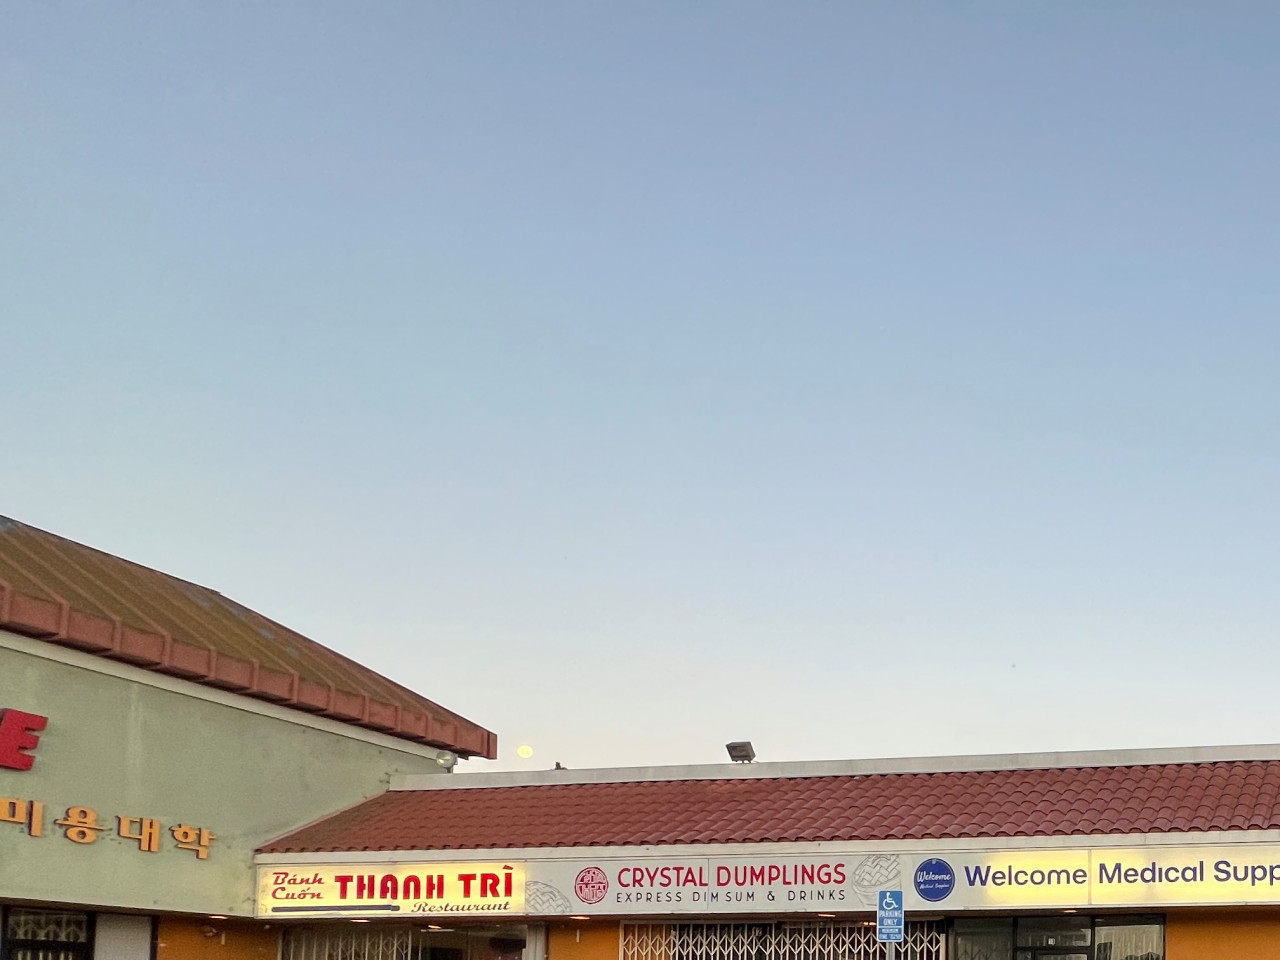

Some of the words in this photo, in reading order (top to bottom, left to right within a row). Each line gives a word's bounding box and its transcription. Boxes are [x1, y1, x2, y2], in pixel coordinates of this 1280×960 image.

[617, 866, 708, 888] CRYSTAL
[716, 863, 846, 887] DUMPLINGS
[917, 871, 952, 882] Welcome
[964, 865, 1087, 887] Welcome
[1099, 861, 1204, 884] Medical
[272, 871, 325, 886] Bánh
[334, 874, 445, 899] THANH
[616, 892, 682, 903] EXPRESS
[766, 891, 775, 901] &
[788, 890, 845, 901] DRINKS
[411, 901, 511, 914] Restaurant
[883, 918, 898, 926] ONLY
